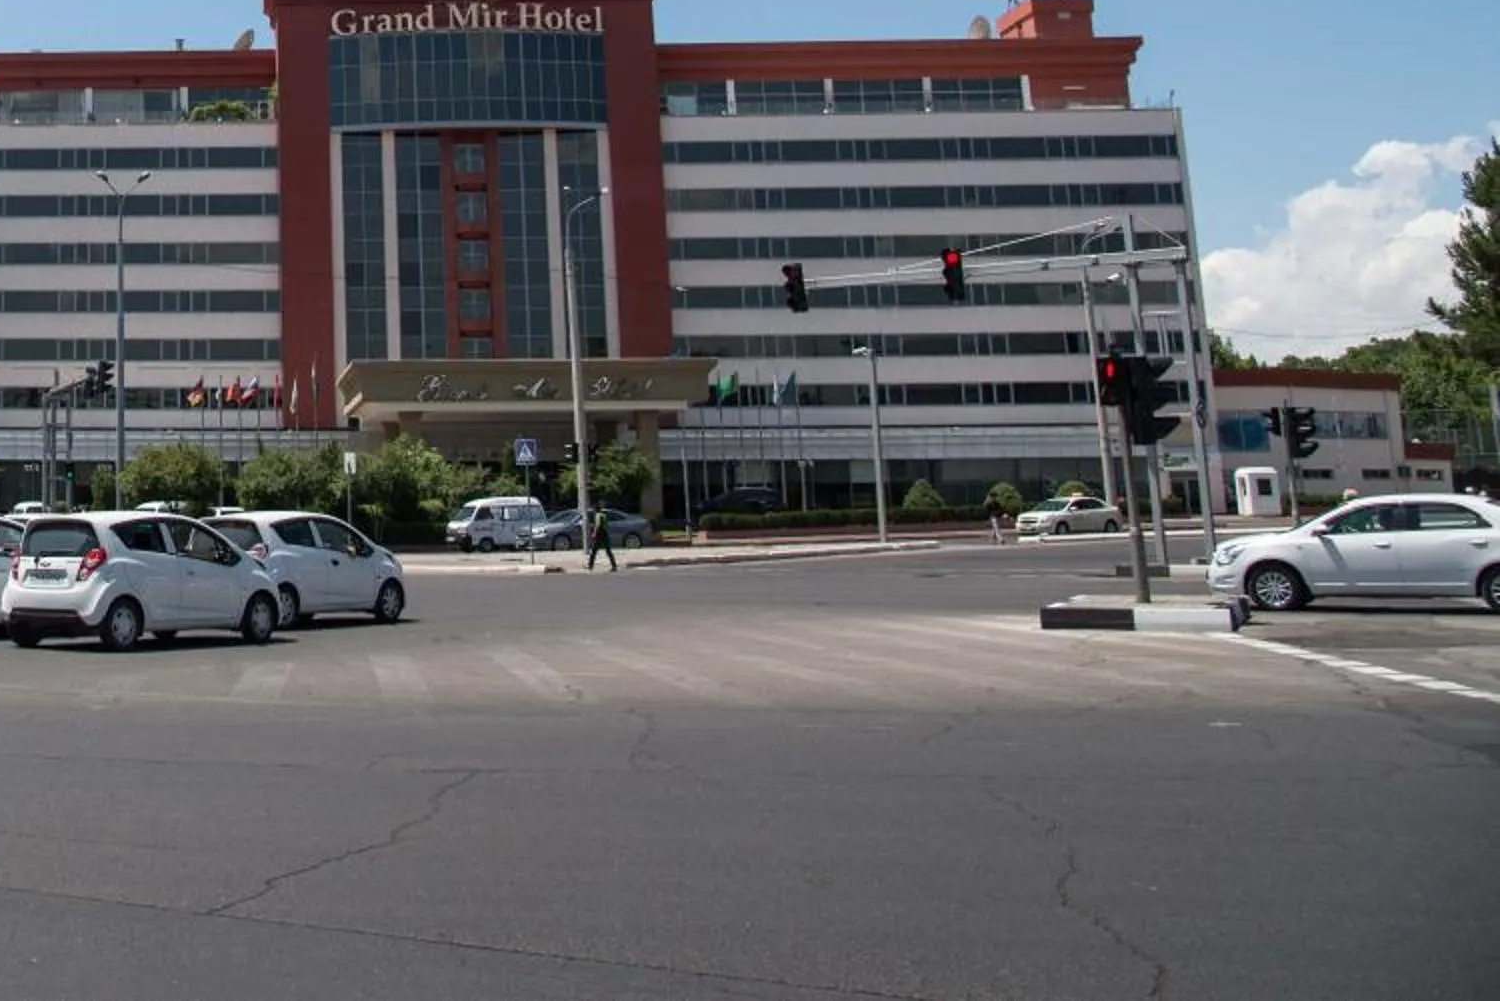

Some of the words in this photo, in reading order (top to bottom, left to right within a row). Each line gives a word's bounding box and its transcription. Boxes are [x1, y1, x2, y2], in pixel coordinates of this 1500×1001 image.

[331, 4, 434, 36] Grand
[449, 2, 507, 30] Mir
[516, 2, 604, 32] Hotel
